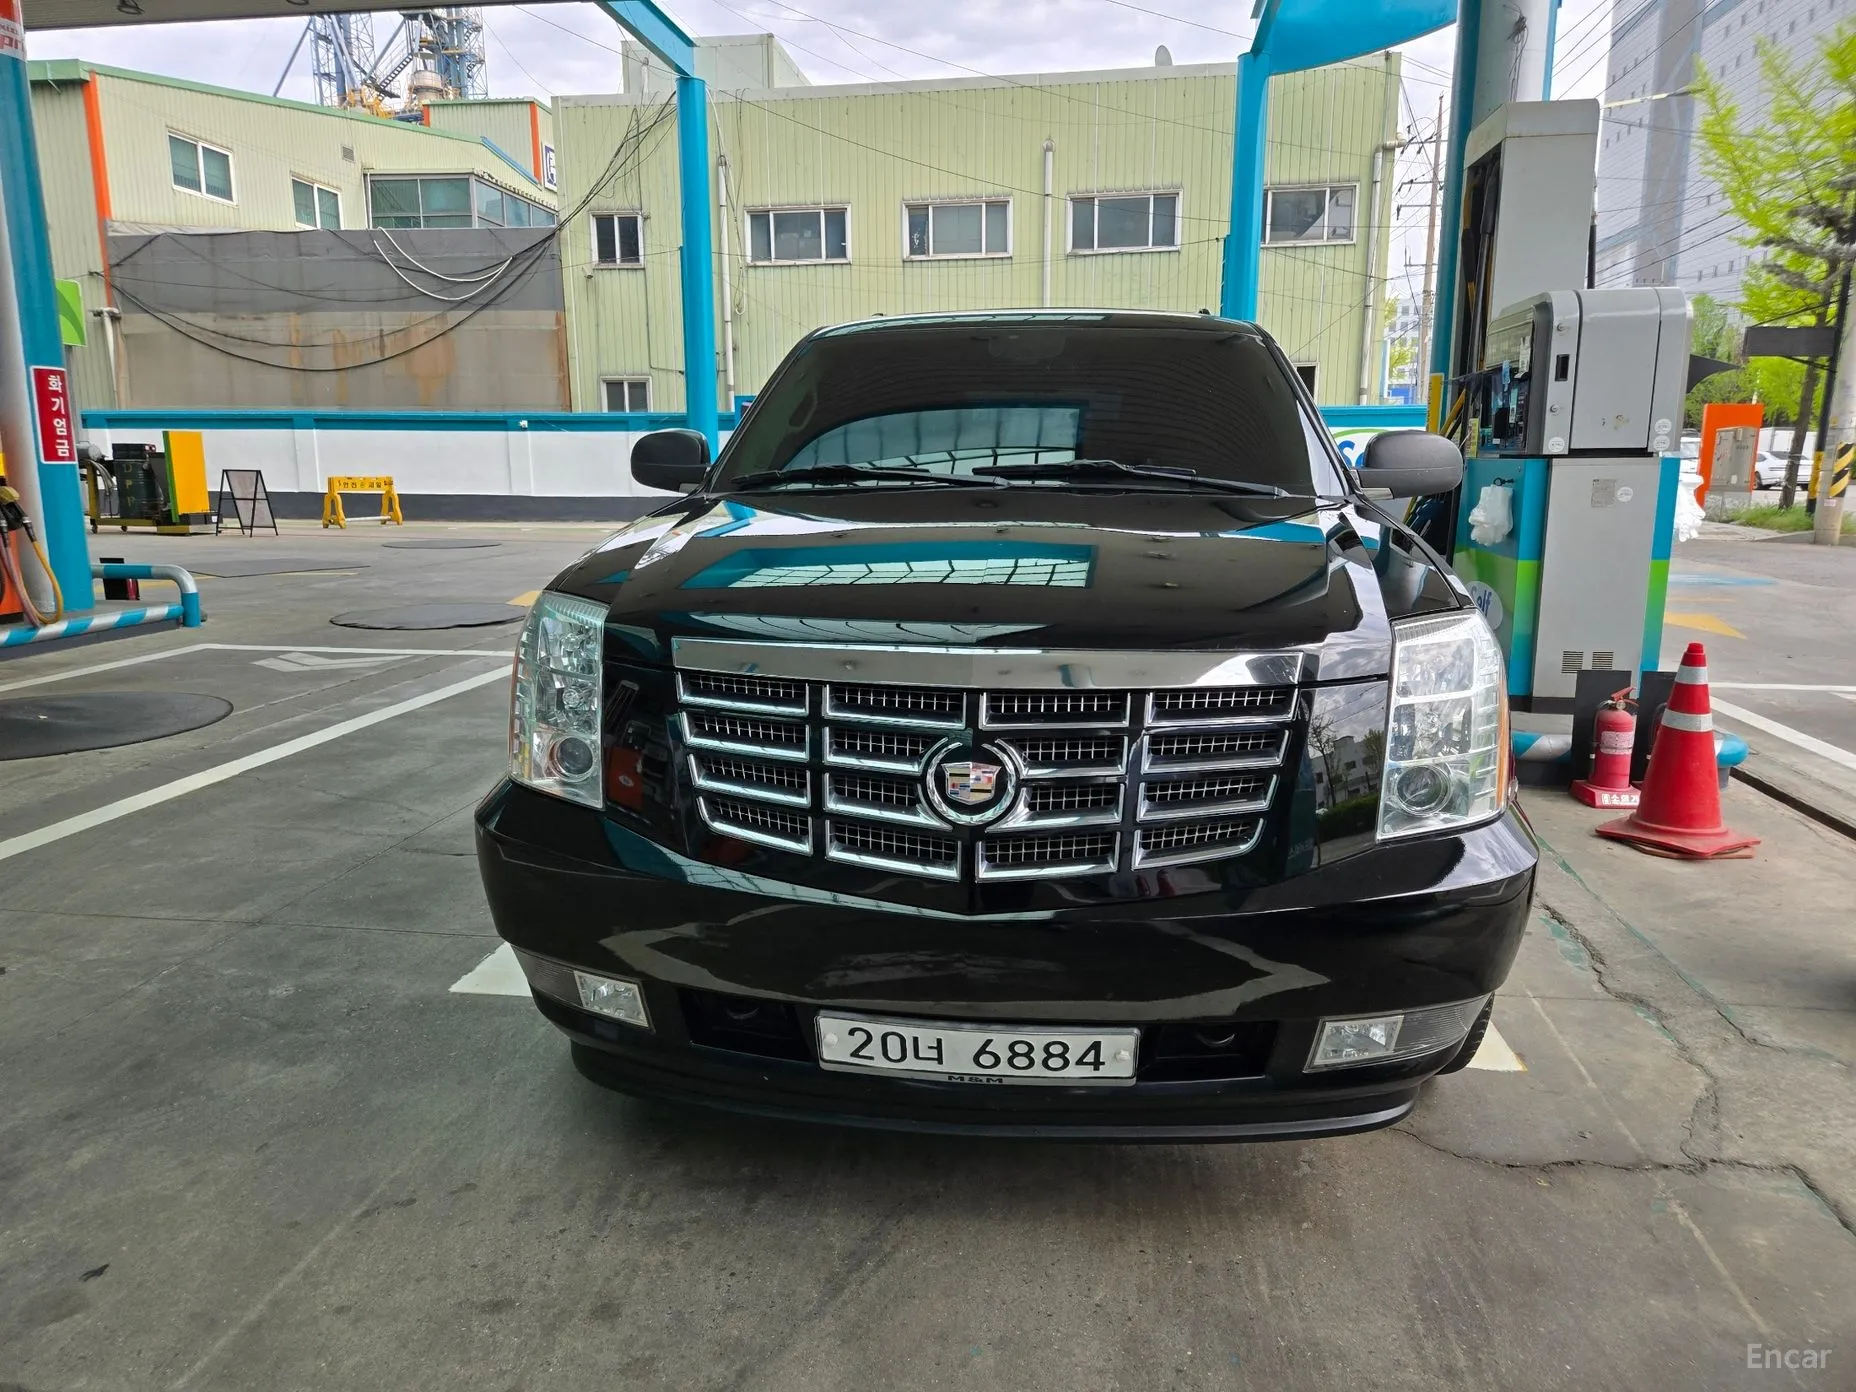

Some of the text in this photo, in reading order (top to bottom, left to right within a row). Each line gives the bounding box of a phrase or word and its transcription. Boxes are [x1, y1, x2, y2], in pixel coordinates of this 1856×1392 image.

[48, 375, 70, 457] 화기엄금
[848, 1027, 1106, 1072] 20너 6884
[947, 1075, 1004, 1084] M&M
